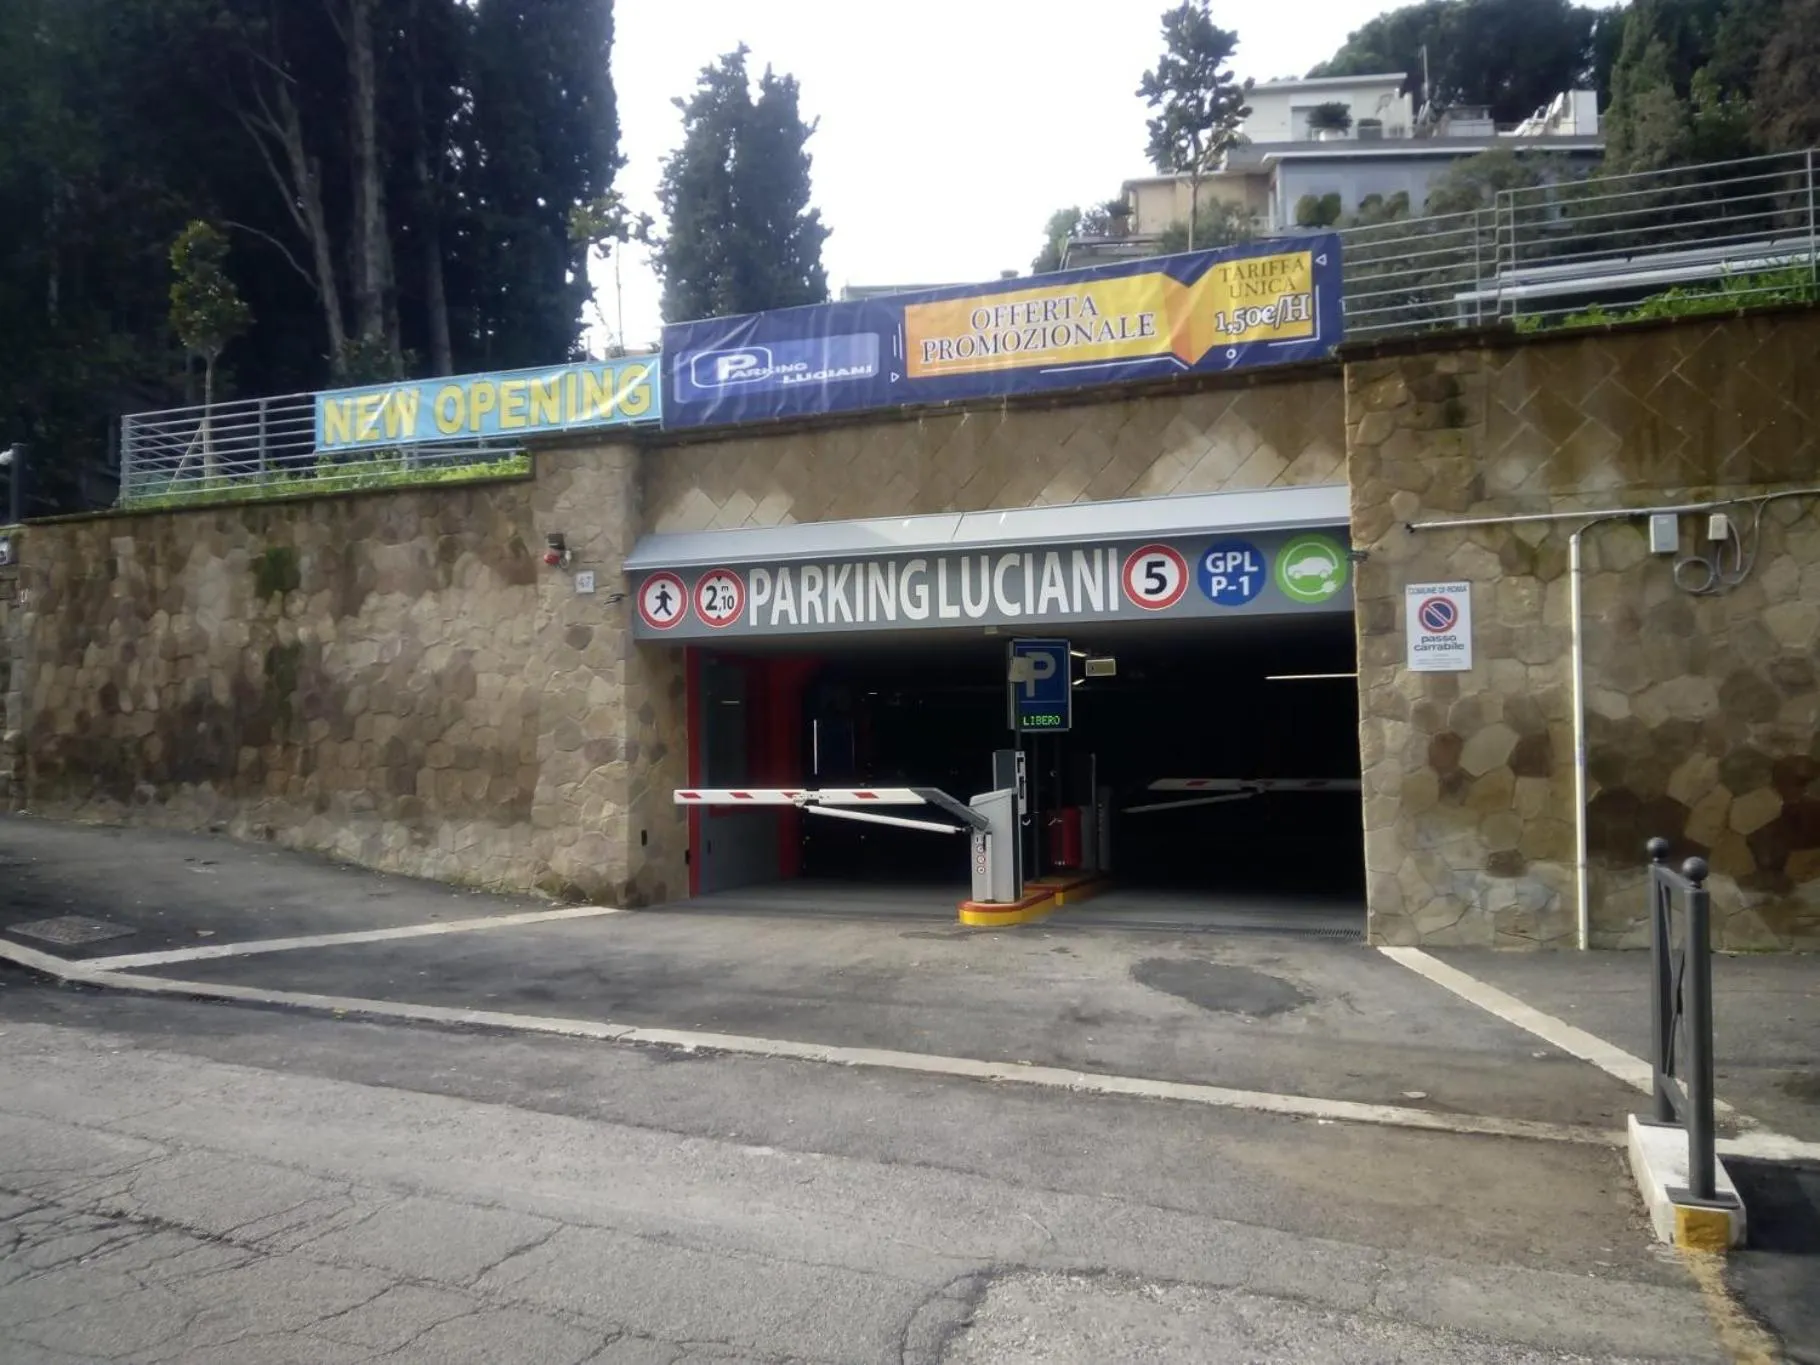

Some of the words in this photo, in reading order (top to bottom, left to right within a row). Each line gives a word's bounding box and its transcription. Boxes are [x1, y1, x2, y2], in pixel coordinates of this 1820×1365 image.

[1219, 258, 1305, 283] TARIFFA
[1229, 275, 1297, 299] UNICA
[970, 295, 1098, 331] OFFERTA
[920, 313, 1156, 363] PROMOZIONALE
[783, 364, 873, 384] LUCIANI
[324, 385, 421, 445] NEW
[434, 364, 652, 435] OPENING
[1205, 551, 1259, 574] GPL
[1144, 560, 1168, 596] 5
[1211, 574, 1251, 598] P-1
[1413, 643, 1465, 651] carrabile
[1421, 635, 1457, 644] passo
[1025, 651, 1056, 697] P
[1023, 715, 1061, 726] LIBERO
